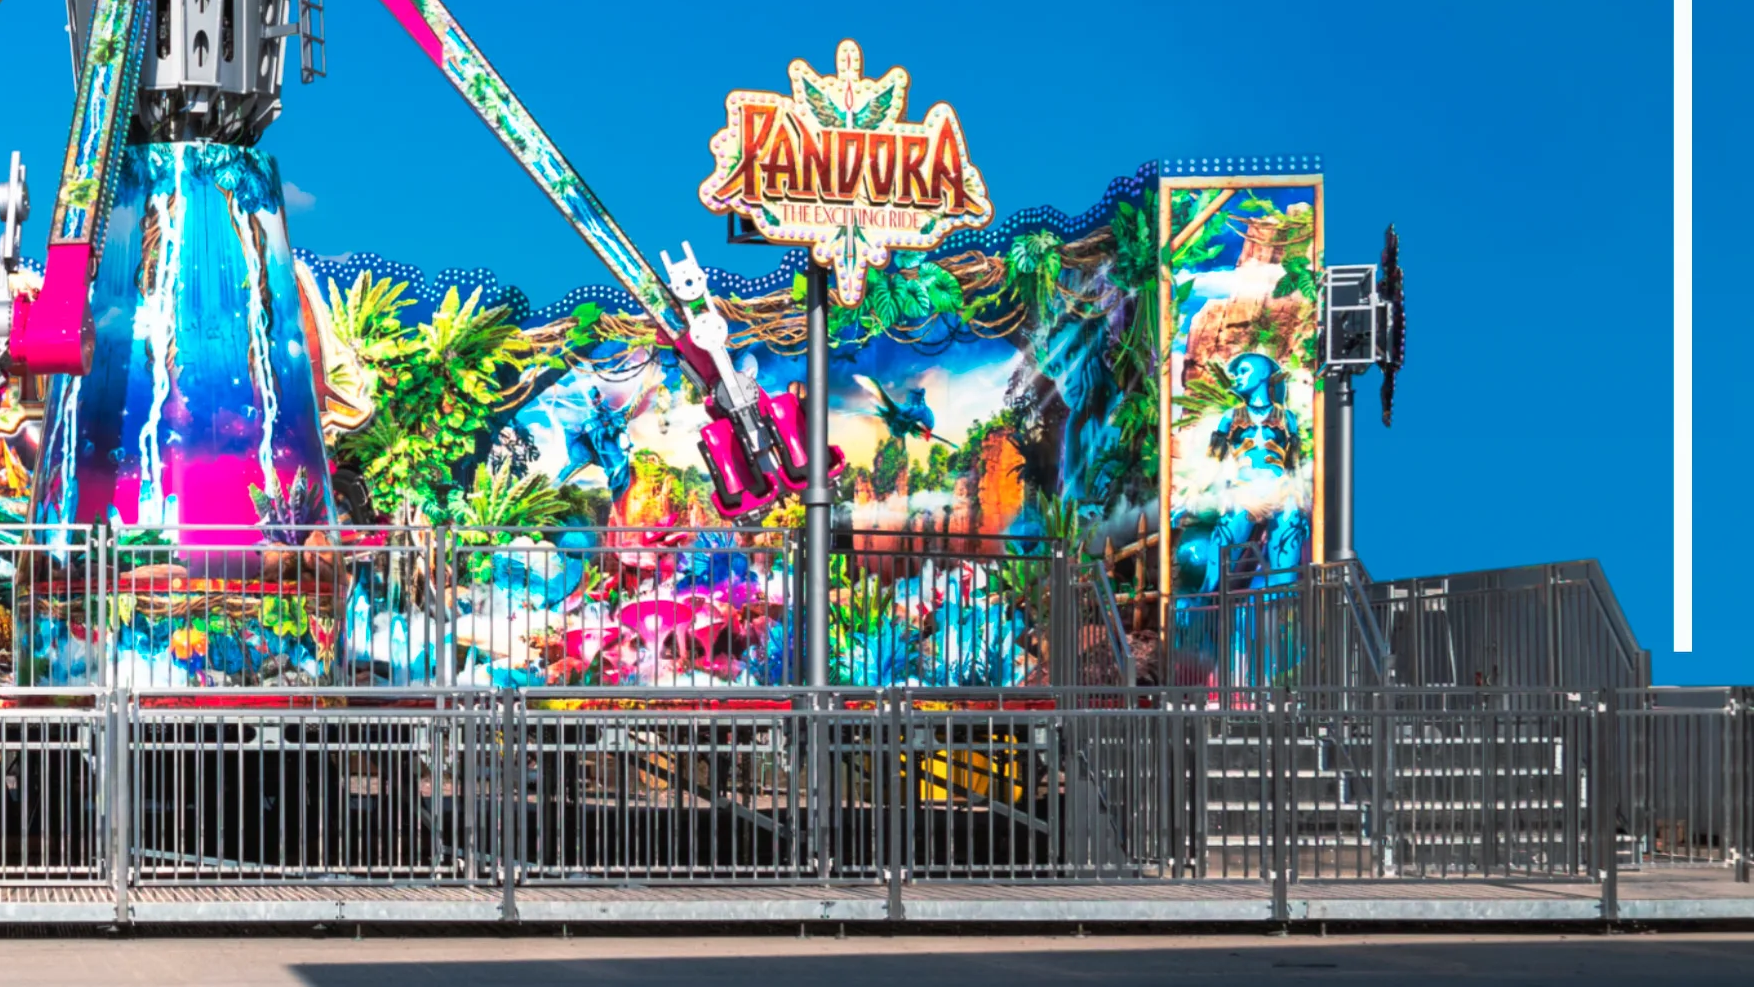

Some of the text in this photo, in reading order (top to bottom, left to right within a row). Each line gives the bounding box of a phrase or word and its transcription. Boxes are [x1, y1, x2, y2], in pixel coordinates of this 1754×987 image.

[714, 104, 986, 215] PANDORA
[779, 204, 922, 230] THE EXCITING RIDE
